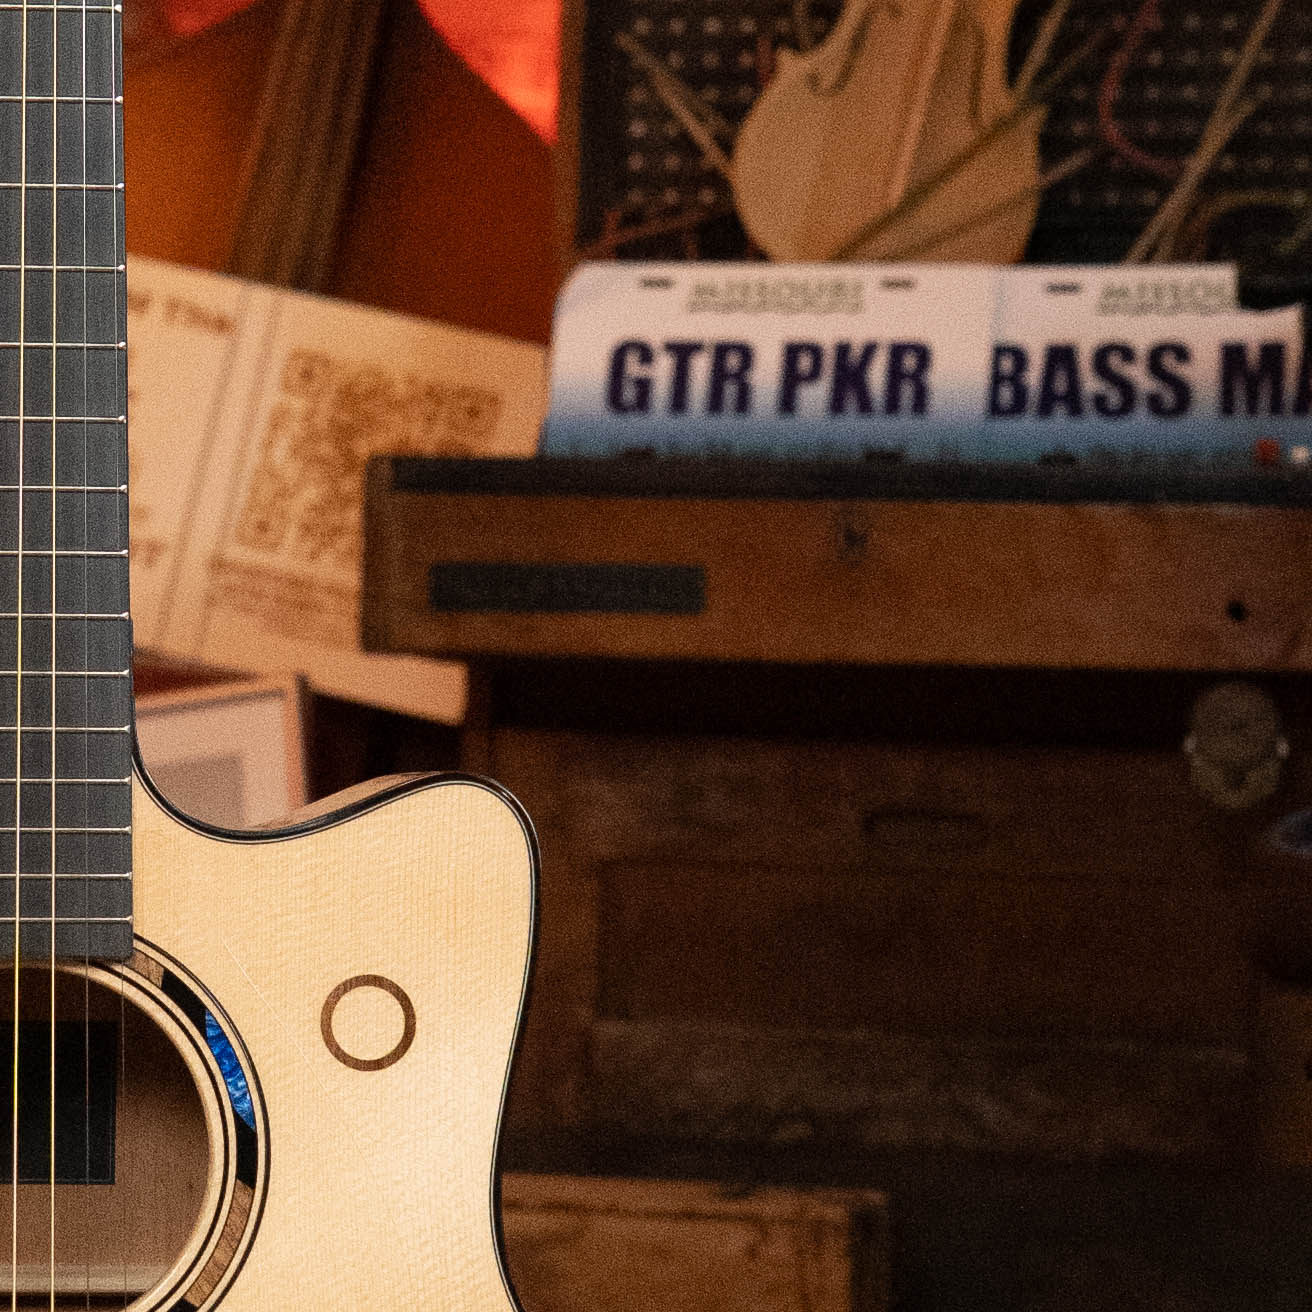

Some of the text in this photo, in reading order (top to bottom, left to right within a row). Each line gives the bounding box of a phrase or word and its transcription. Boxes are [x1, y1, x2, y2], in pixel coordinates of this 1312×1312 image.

[603, 339, 933, 418] GTR PKR
[988, 342, 1193, 419] BASS
